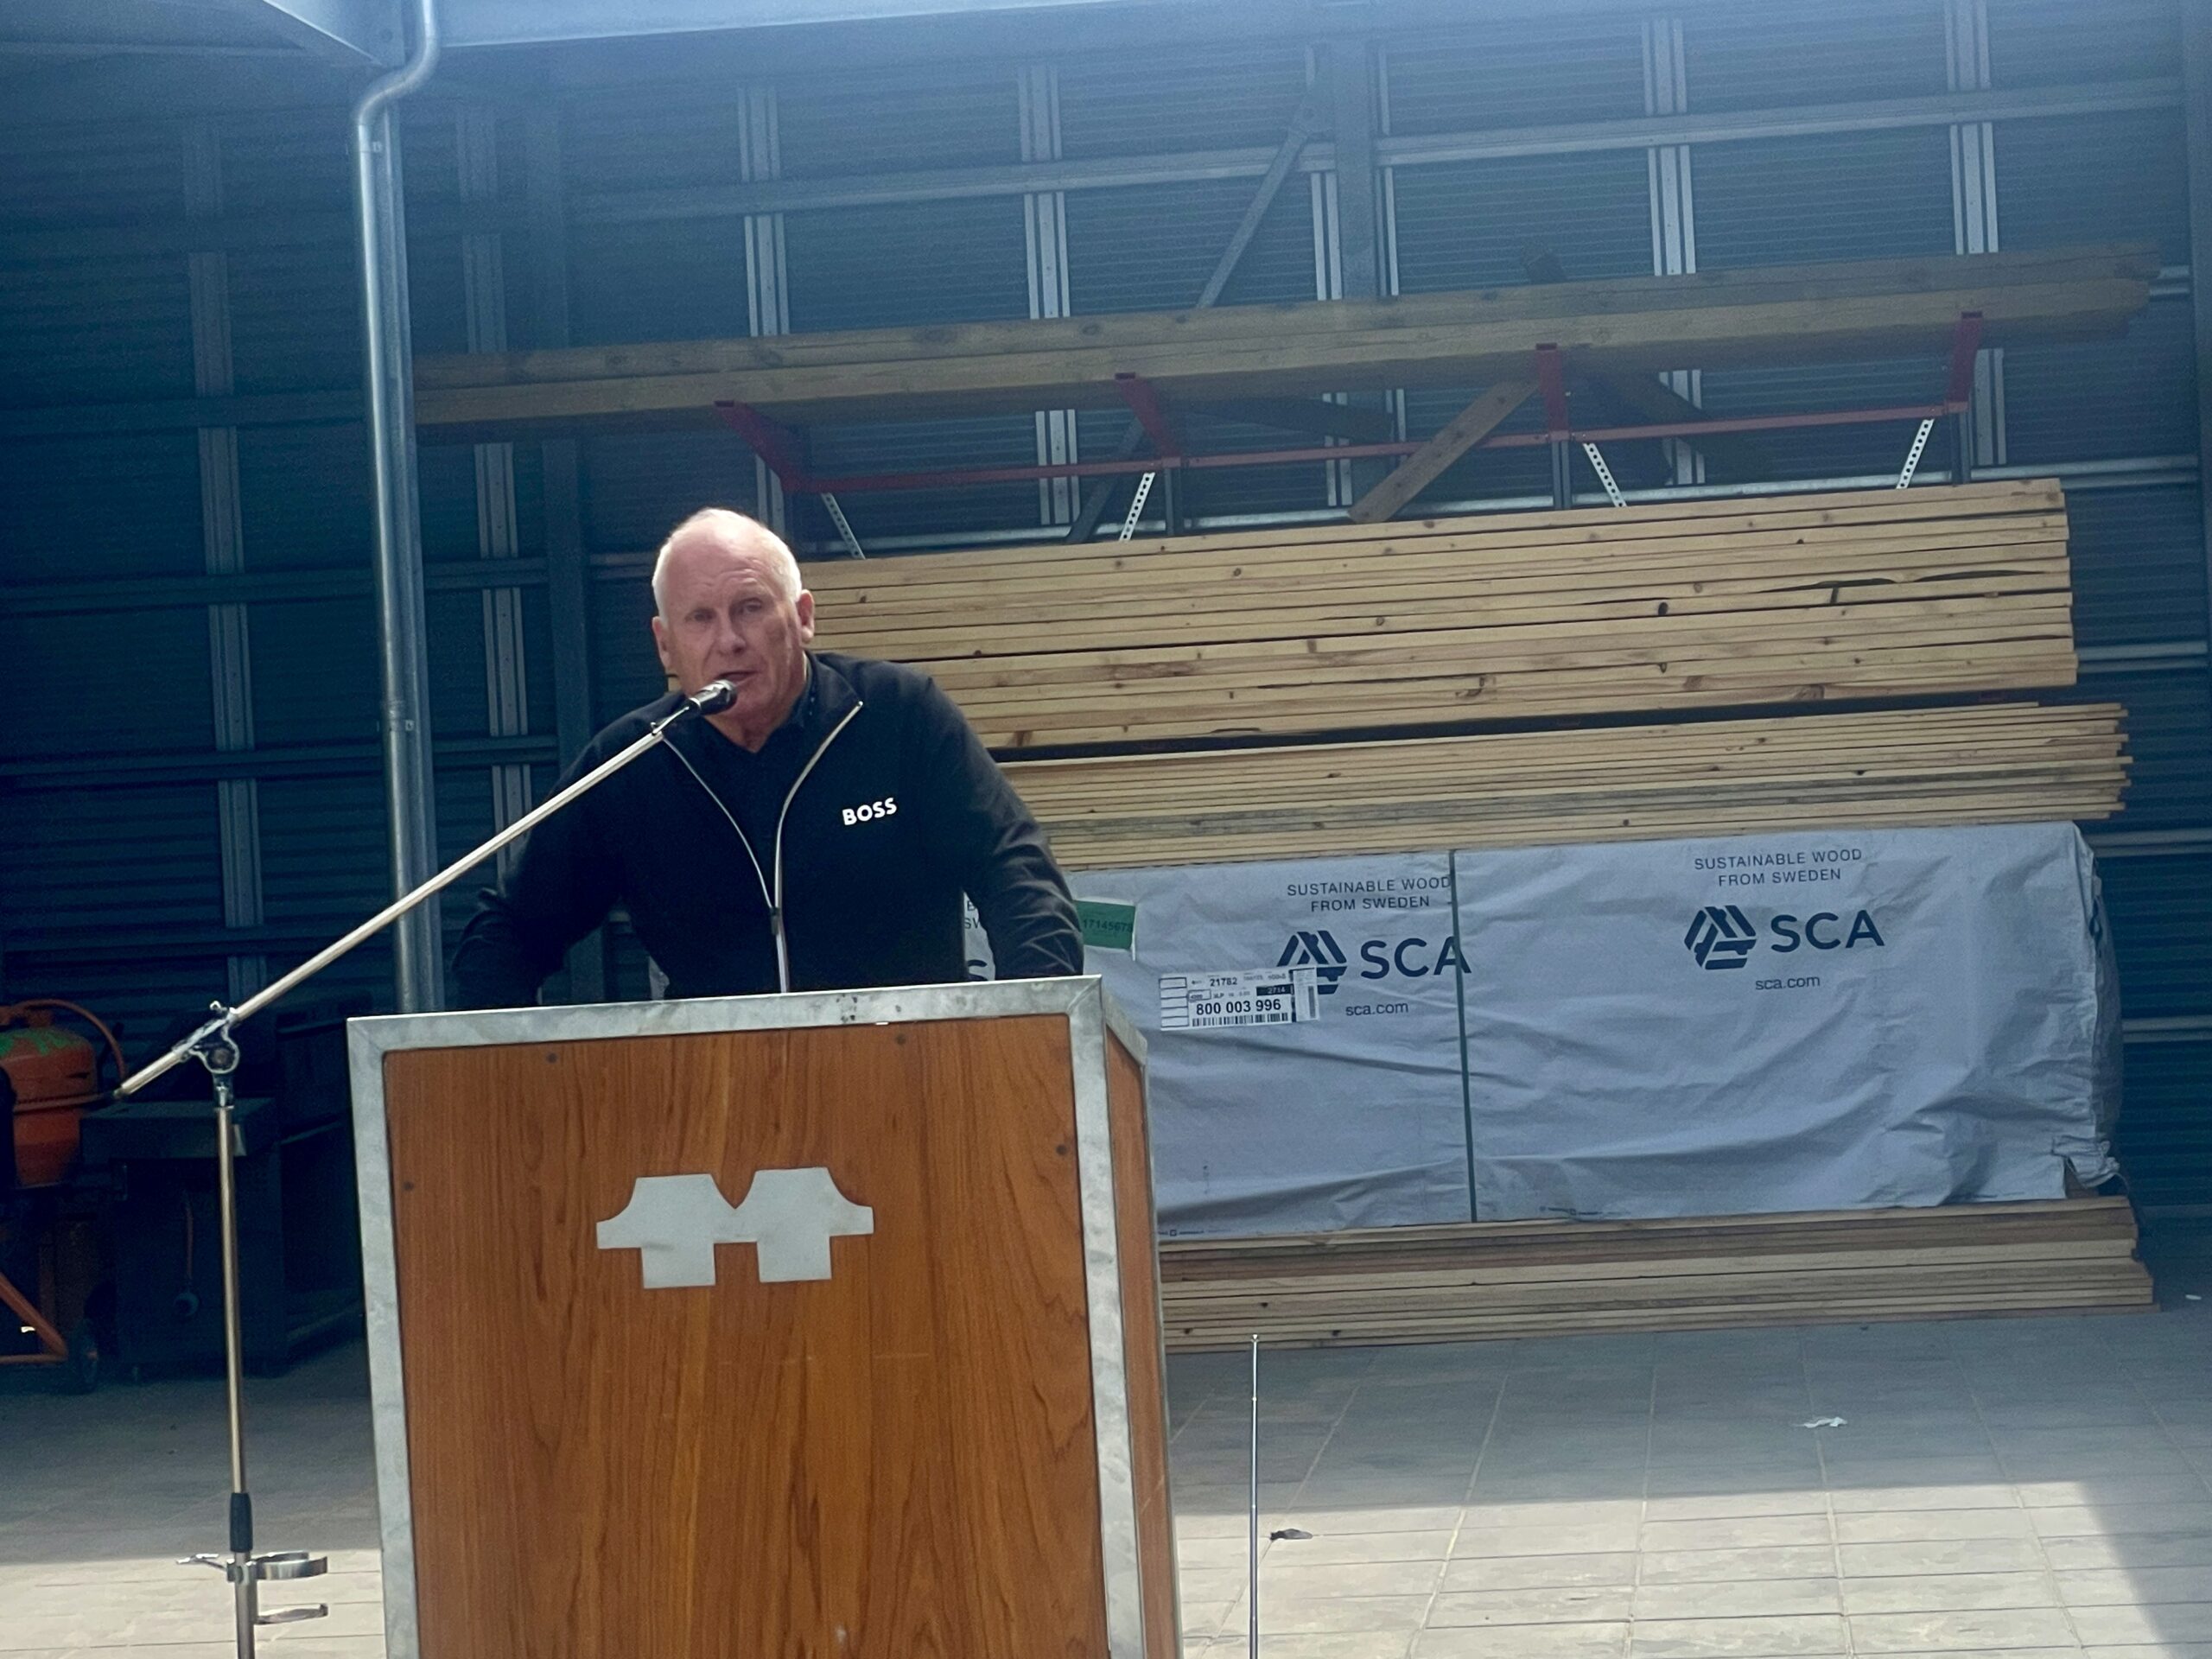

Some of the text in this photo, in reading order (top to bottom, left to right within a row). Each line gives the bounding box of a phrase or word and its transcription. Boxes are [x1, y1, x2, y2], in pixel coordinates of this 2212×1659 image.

[842, 797, 898, 825] BOSS
[1694, 848, 1863, 870] SUSTAINABLE WOOD
[1287, 876, 1452, 896] SUSTAINABLE WOOD
[1718, 868, 1841, 887] FROM SWEDEN
[1311, 895, 1430, 912] FROM SWEDEN
[1770, 909, 1885, 953] SCA
[1360, 936, 1472, 979] SCA
[1755, 975, 1821, 990] sca.com
[1196, 999, 1281, 1015] 800 003 996
[1344, 1002, 1409, 1016] sca.com
